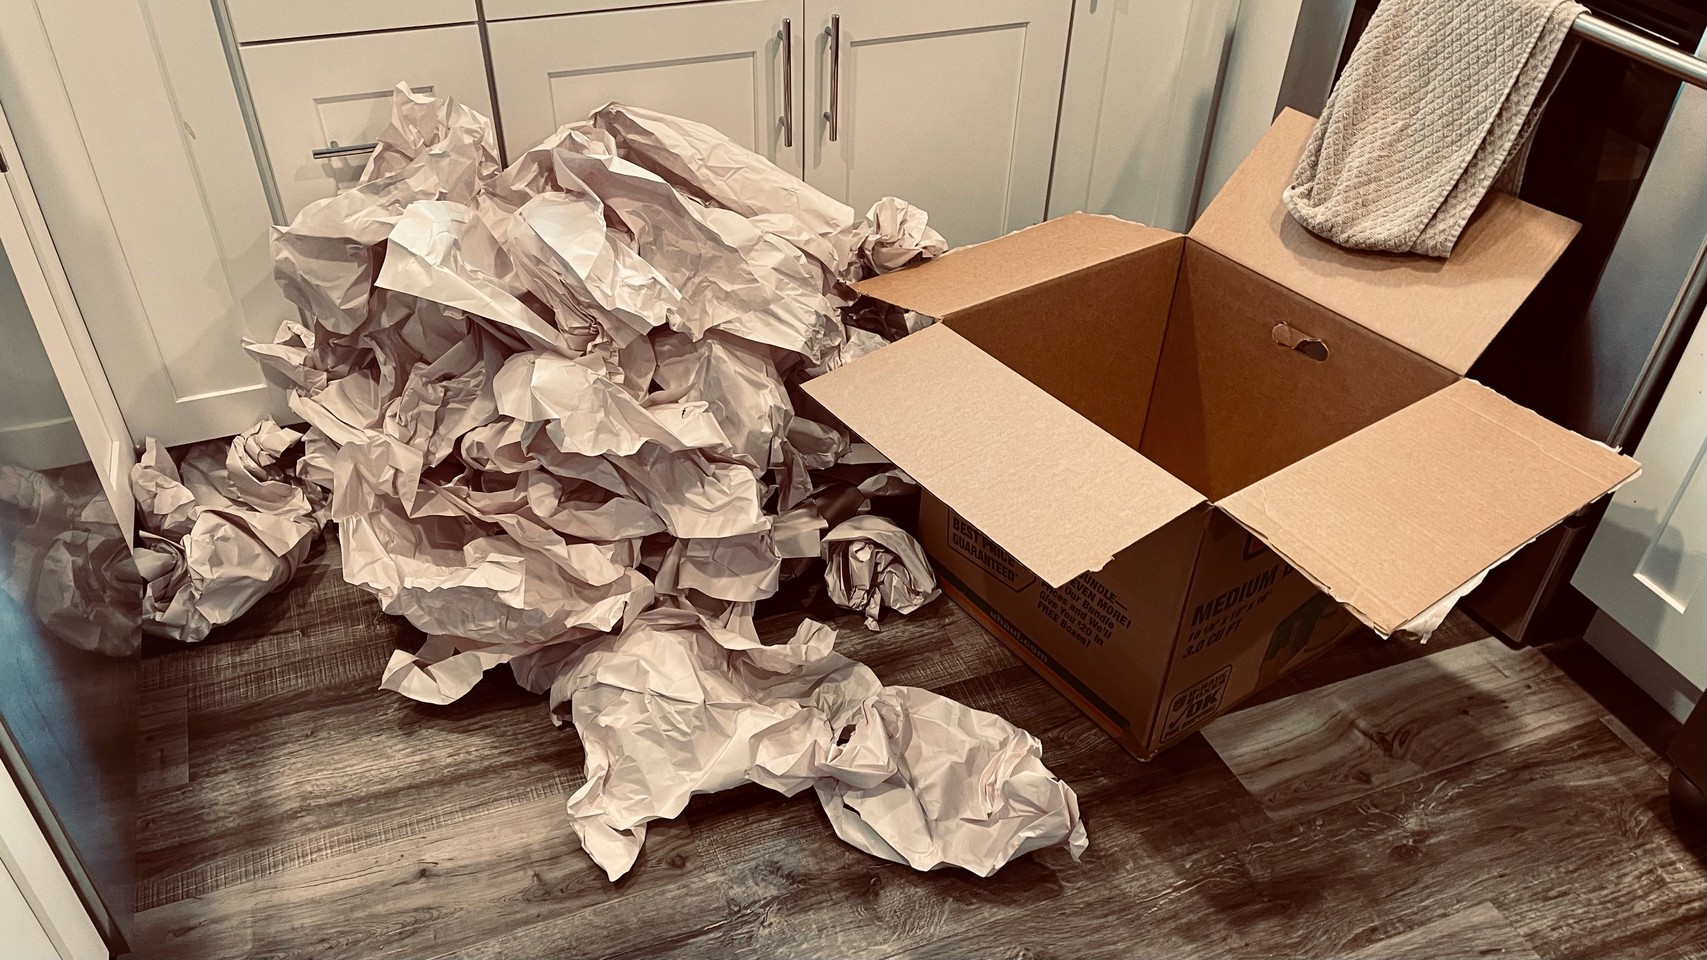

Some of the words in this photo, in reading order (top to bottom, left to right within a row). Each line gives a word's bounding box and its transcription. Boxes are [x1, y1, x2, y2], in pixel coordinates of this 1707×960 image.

[953, 517, 979, 544] BEST
[1039, 590, 1058, 609] Give
[1060, 606, 1077, 624] You
[1064, 586, 1081, 602] Our
[1082, 600, 1115, 630] Bundle
[1070, 579, 1097, 602] EVEN
[1096, 598, 1132, 629] MORE!
[1191, 564, 1279, 627] MEDIUM
[990, 610, 1048, 662] uhaul.com
[1037, 601, 1059, 623] FREE
[1060, 619, 1091, 648] Boxes!
[1069, 604, 1087, 620] and
[1088, 618, 1112, 639] We'll
[1183, 638, 1206, 659] 3.0
[1207, 627, 1226, 647] CU
[1226, 617, 1244, 636] FT
[1186, 687, 1222, 718] OK
